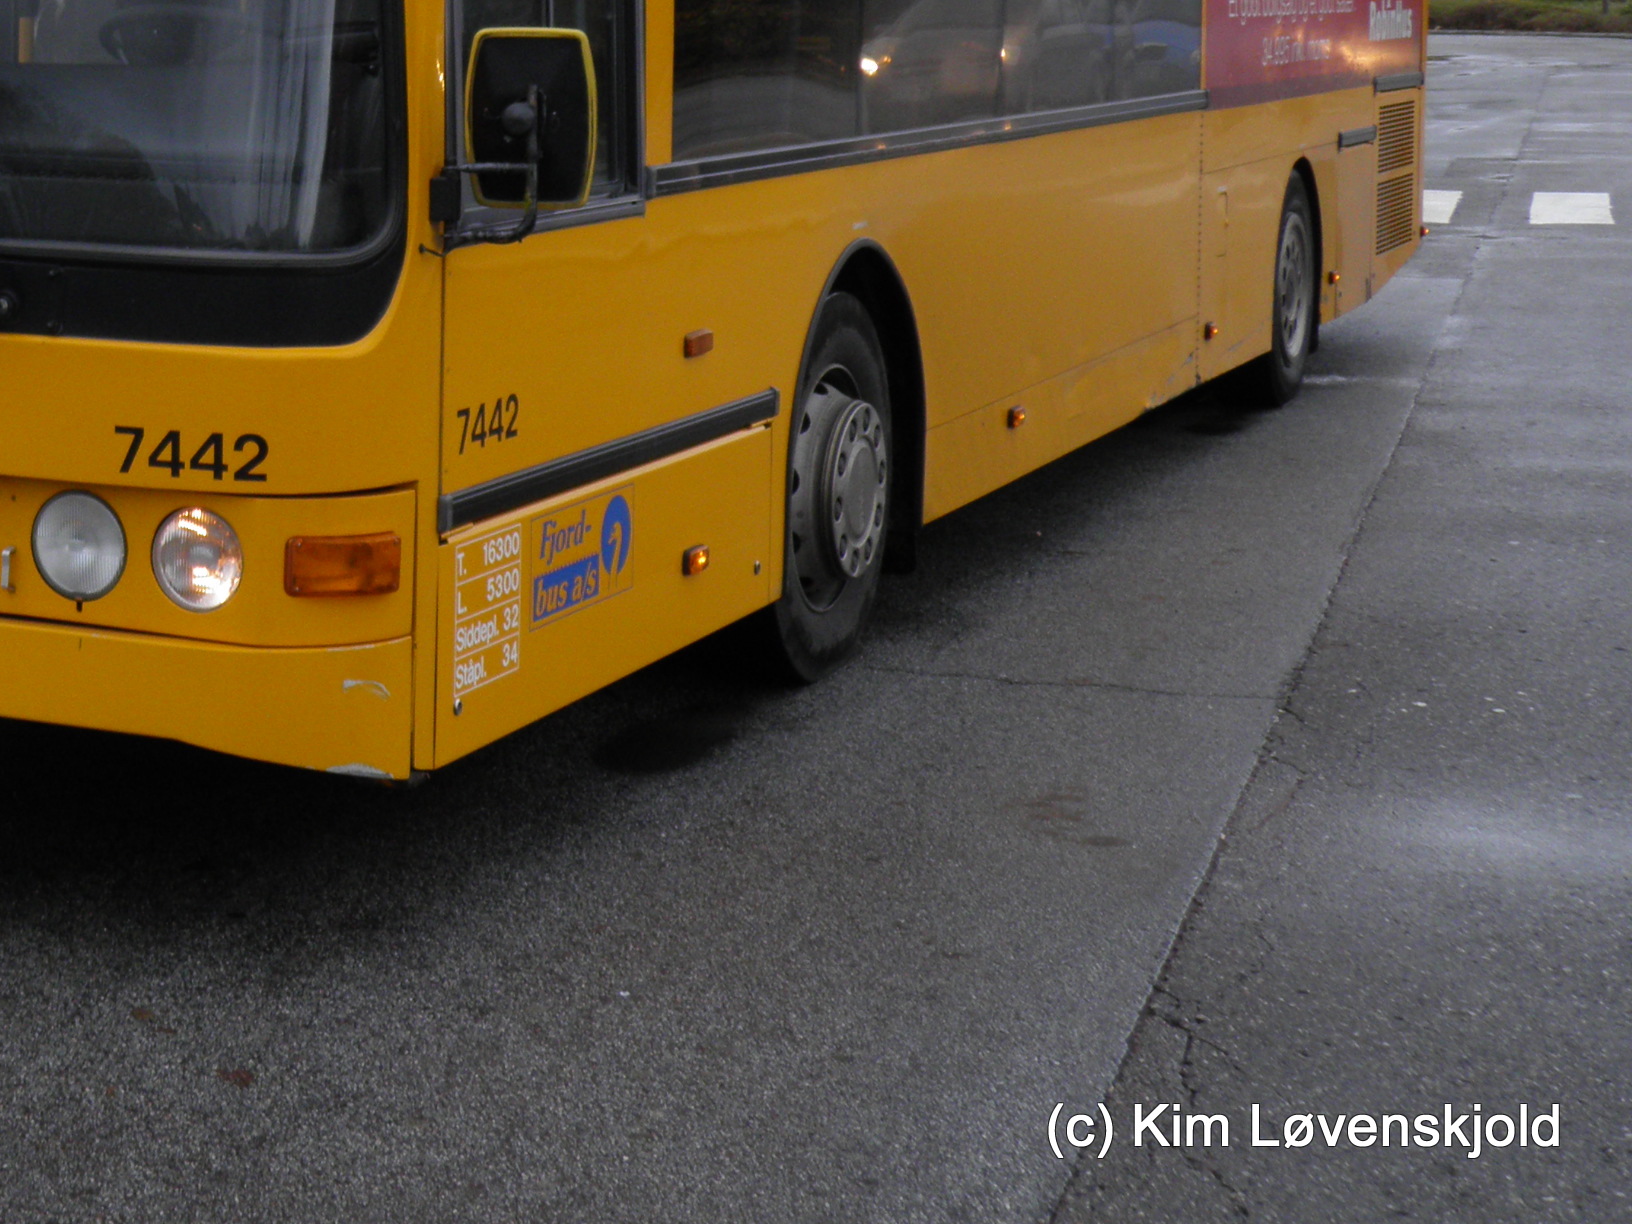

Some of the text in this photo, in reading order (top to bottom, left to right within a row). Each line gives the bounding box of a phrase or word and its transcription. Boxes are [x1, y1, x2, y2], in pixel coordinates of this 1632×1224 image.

[457, 393, 519, 455] 7442
[113, 425, 270, 483] 7442
[456, 531, 520, 576] T. 16300
[539, 509, 593, 566] Fjord-
[457, 566, 520, 614] L. 5300
[535, 561, 598, 619] bus a/s
[456, 603, 519, 654] Siddepl. 32
[455, 641, 518, 690] Ståpl. 34
